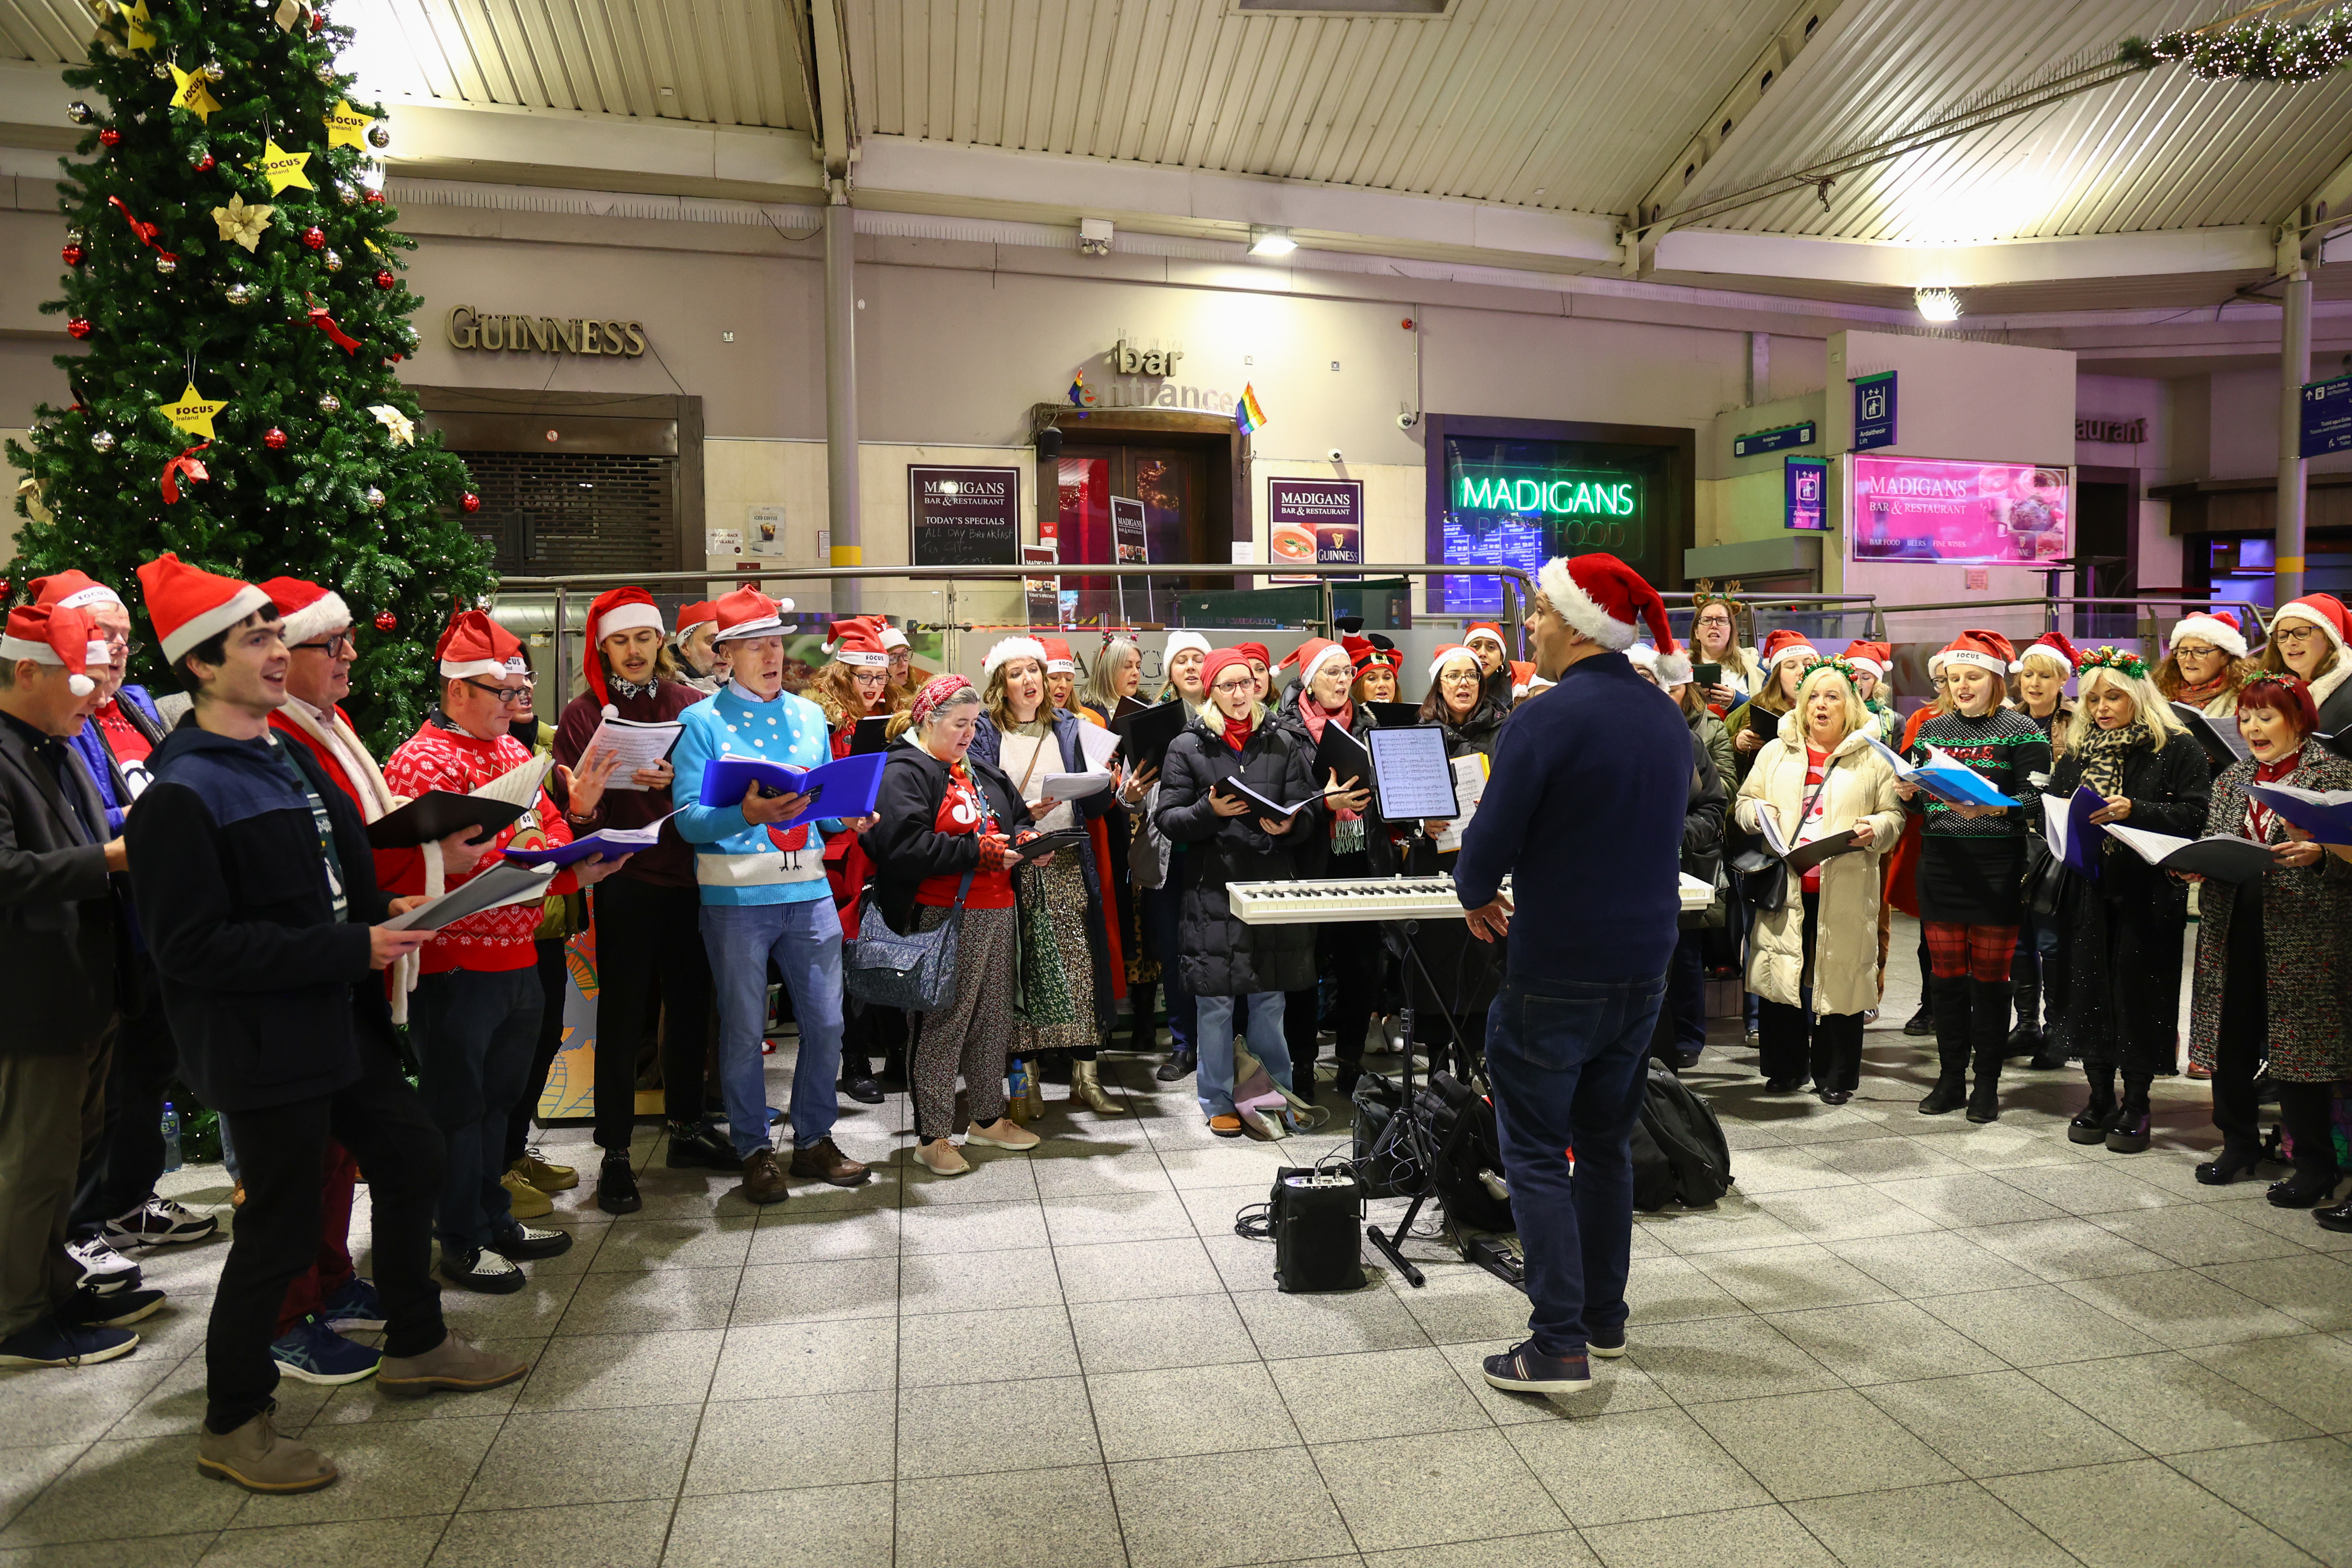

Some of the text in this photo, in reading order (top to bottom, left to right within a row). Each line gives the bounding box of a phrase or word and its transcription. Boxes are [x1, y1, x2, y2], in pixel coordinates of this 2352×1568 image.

[183, 77, 202, 101] FOCUS
[445, 304, 645, 356] GUINNESS
[1117, 339, 1184, 377] bar
[1079, 377, 1233, 413] entrance
[176, 405, 214, 415] FOCUS
[2076, 418, 2149, 442] aurant
[1869, 476, 1967, 498] MADIGANS
[942, 496, 952, 506] &
[1280, 492, 1351, 505] MADIGANS
[1464, 477, 1634, 515] MADIGANS
[1296, 506, 1305, 515] &
[1869, 500, 1966, 515] BAR & RESTAURANT
[965, 517, 1004, 525] SPECIALS
[1118, 517, 1142, 529] MADIGANS
[925, 527, 942, 538] ALL
[1318, 548, 1358, 562] GUINNESS
